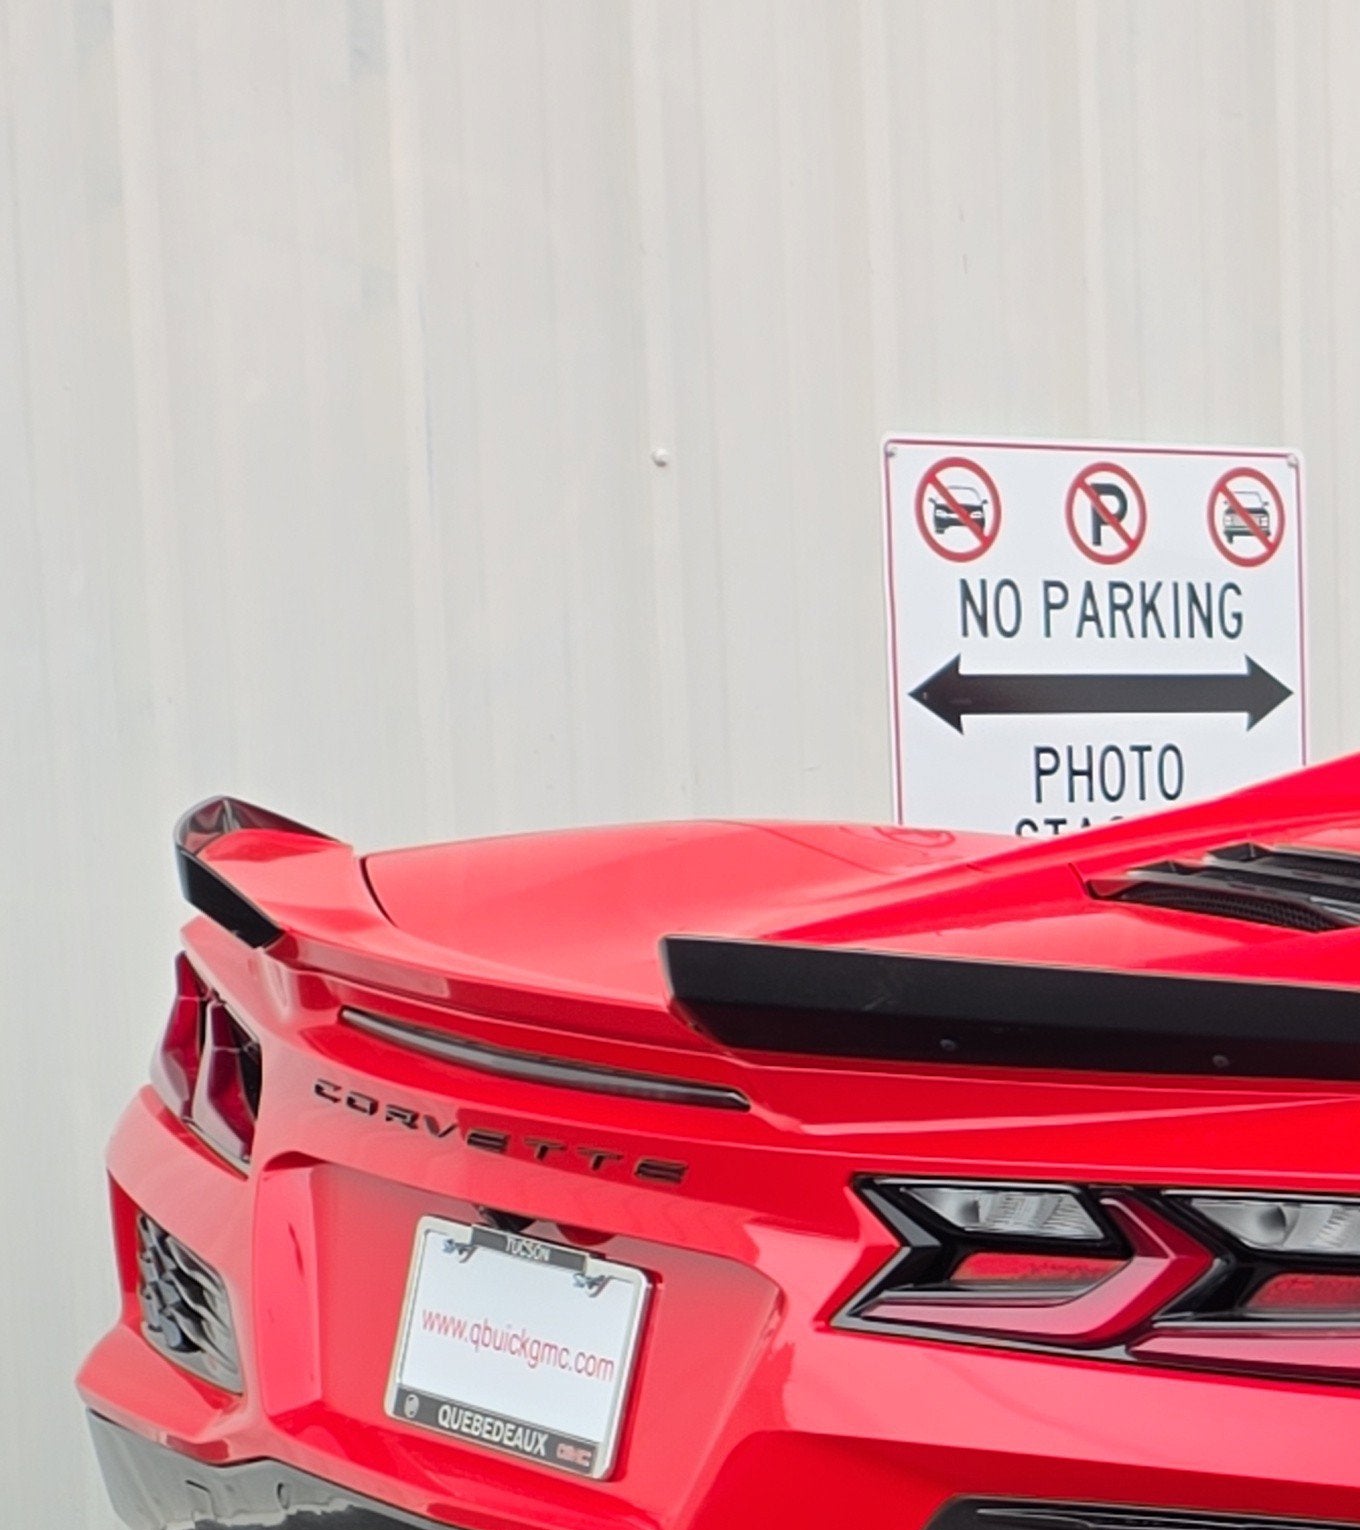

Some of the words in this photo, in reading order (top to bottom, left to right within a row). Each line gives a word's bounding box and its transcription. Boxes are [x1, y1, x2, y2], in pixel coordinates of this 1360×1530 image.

[958, 577, 1022, 638] NO
[1042, 579, 1243, 639] PARKING
[1033, 743, 1184, 803] PHOTO
[313, 1078, 690, 1185] CORVETTE
[505, 1234, 551, 1262] TUCSON
[421, 1308, 615, 1383] www.qbuickgmc.com
[437, 1404, 549, 1457] QUEBEDEAUX
